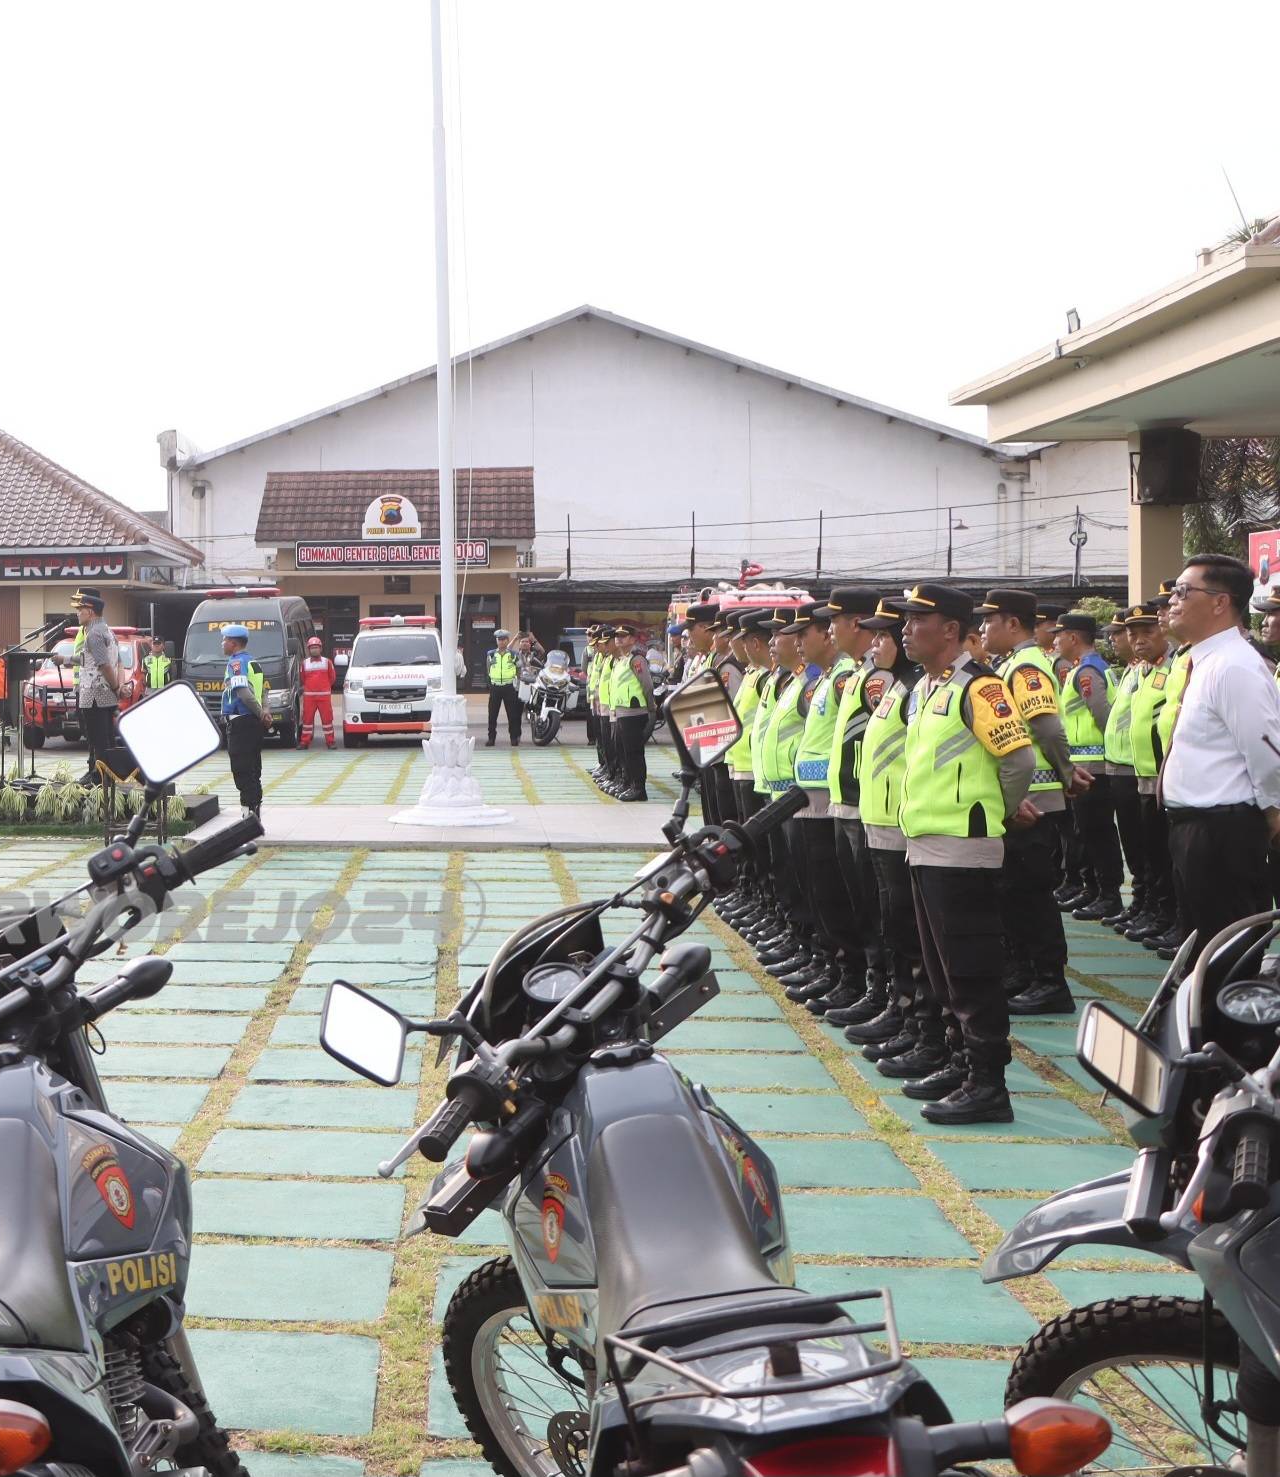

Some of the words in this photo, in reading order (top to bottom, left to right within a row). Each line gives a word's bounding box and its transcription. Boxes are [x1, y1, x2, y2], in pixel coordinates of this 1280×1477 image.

[299, 546, 343, 562] COMMAND
[345, 546, 379, 561] CENTER
[389, 546, 411, 561] CALL
[412, 545, 441, 561] CENTE
[987, 720, 1017, 739] KAPOS
[106, 1252, 177, 1296] POLISI
[532, 1295, 584, 1328] POLISI
